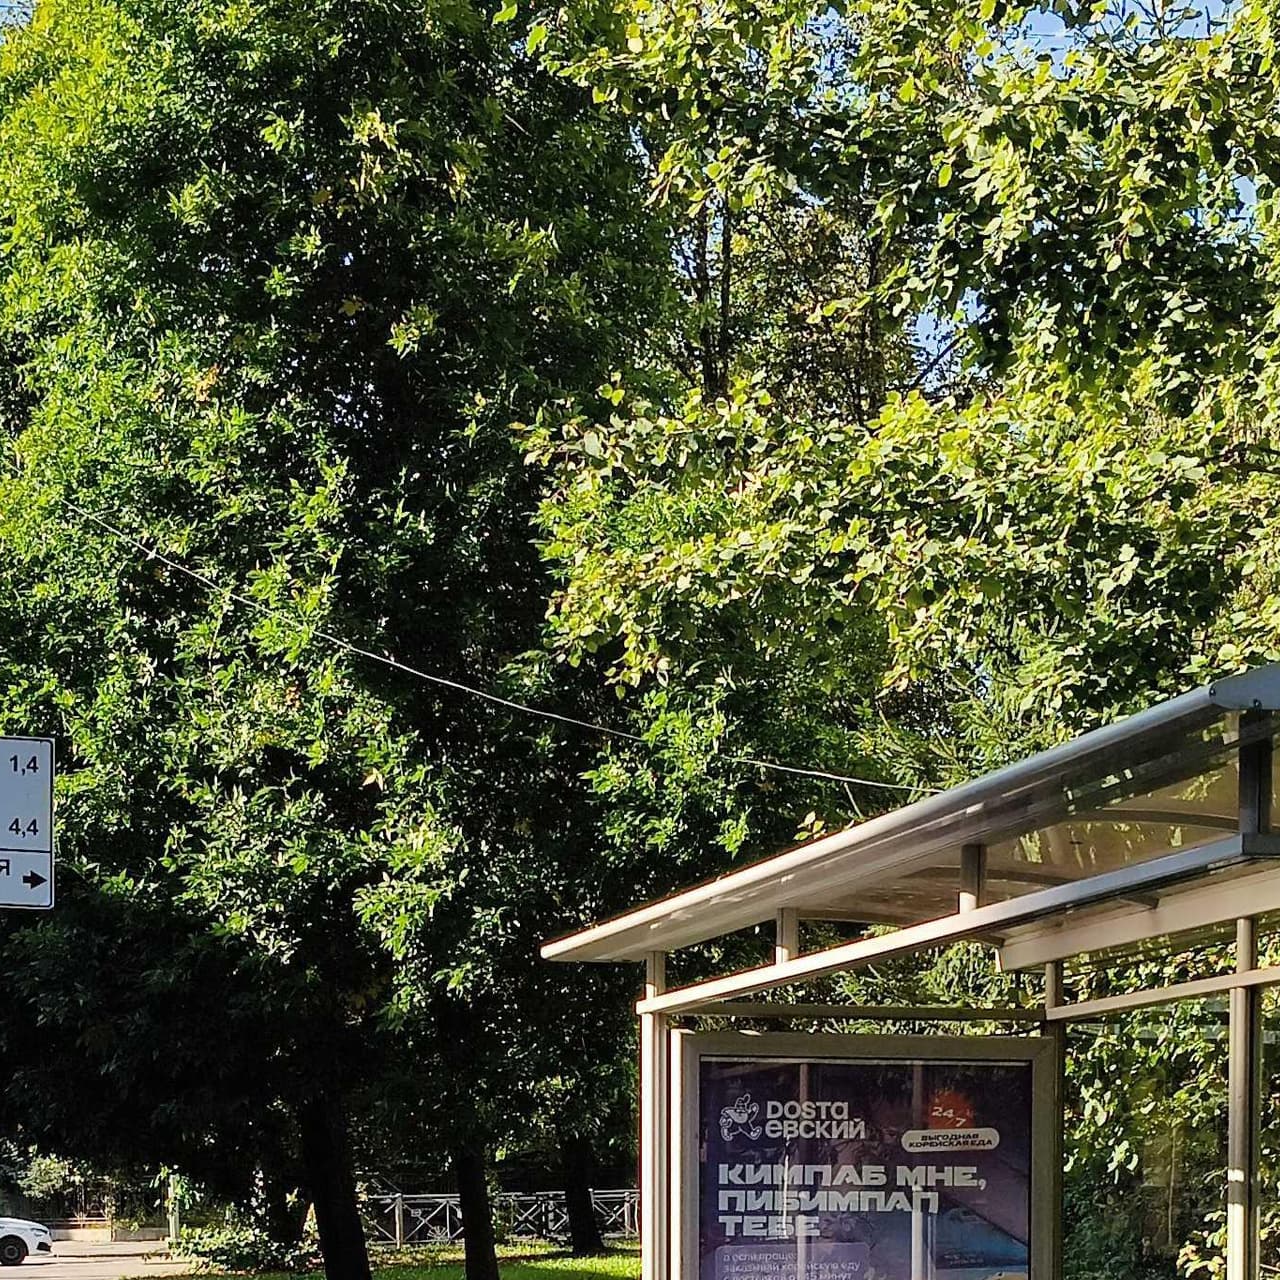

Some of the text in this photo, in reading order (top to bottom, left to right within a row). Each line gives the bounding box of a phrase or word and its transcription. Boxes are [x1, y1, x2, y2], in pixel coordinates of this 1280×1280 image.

[9, 754, 39, 776] 1,4
[8, 818, 39, 839] 4,4
[908, 1139, 969, 1148] КОРЕЙСКАЯ
[921, 1133, 979, 1142] ВЫГОДНАЯ
[718, 1163, 987, 1191] КИМПАБ МНЕ,
[718, 1190, 939, 1214] ПИБИМПАП
[718, 1215, 821, 1238] ТЕБЕ
[782, 1261, 839, 1272] корйскую
